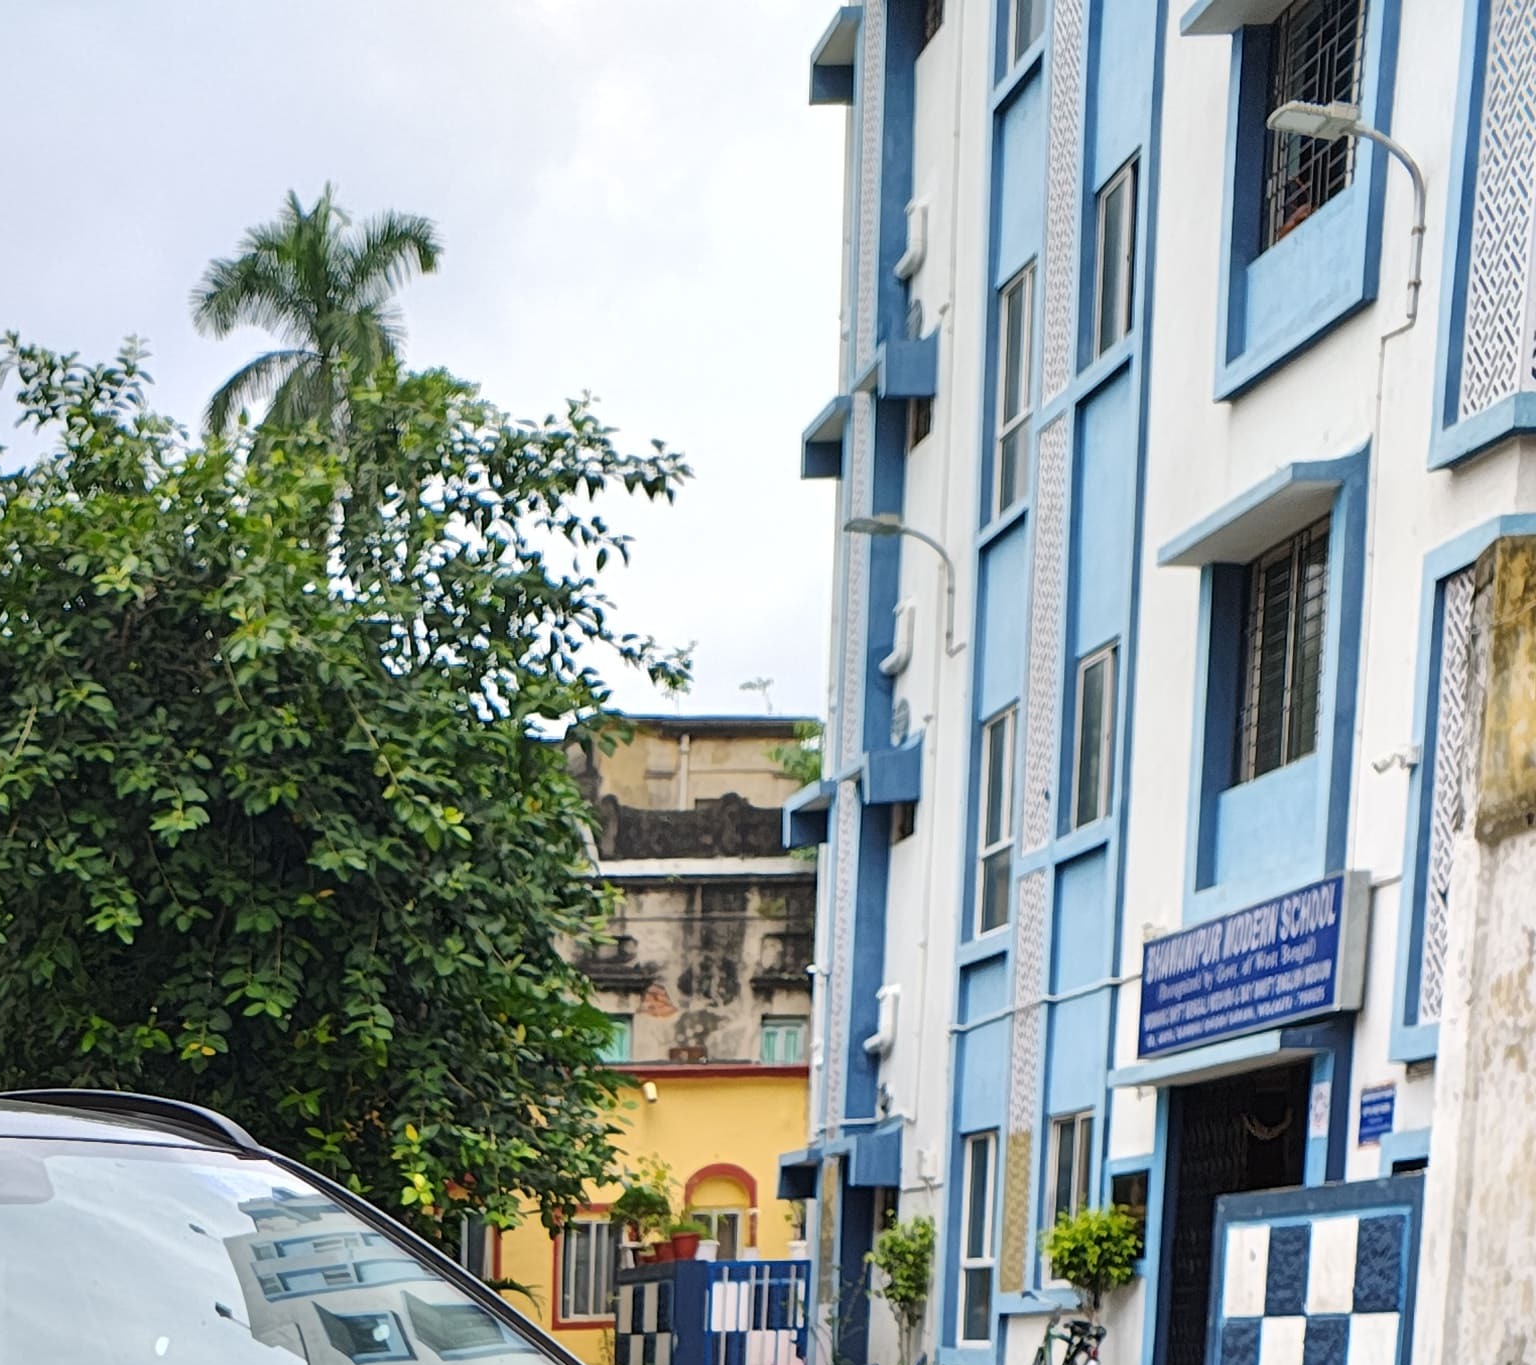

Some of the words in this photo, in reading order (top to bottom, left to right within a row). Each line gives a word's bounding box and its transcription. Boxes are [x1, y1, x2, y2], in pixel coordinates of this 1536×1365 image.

[1223, 903, 1280, 959] MODERN
[1280, 882, 1337, 941] SCHOOL
[1242, 952, 1254, 975] of
